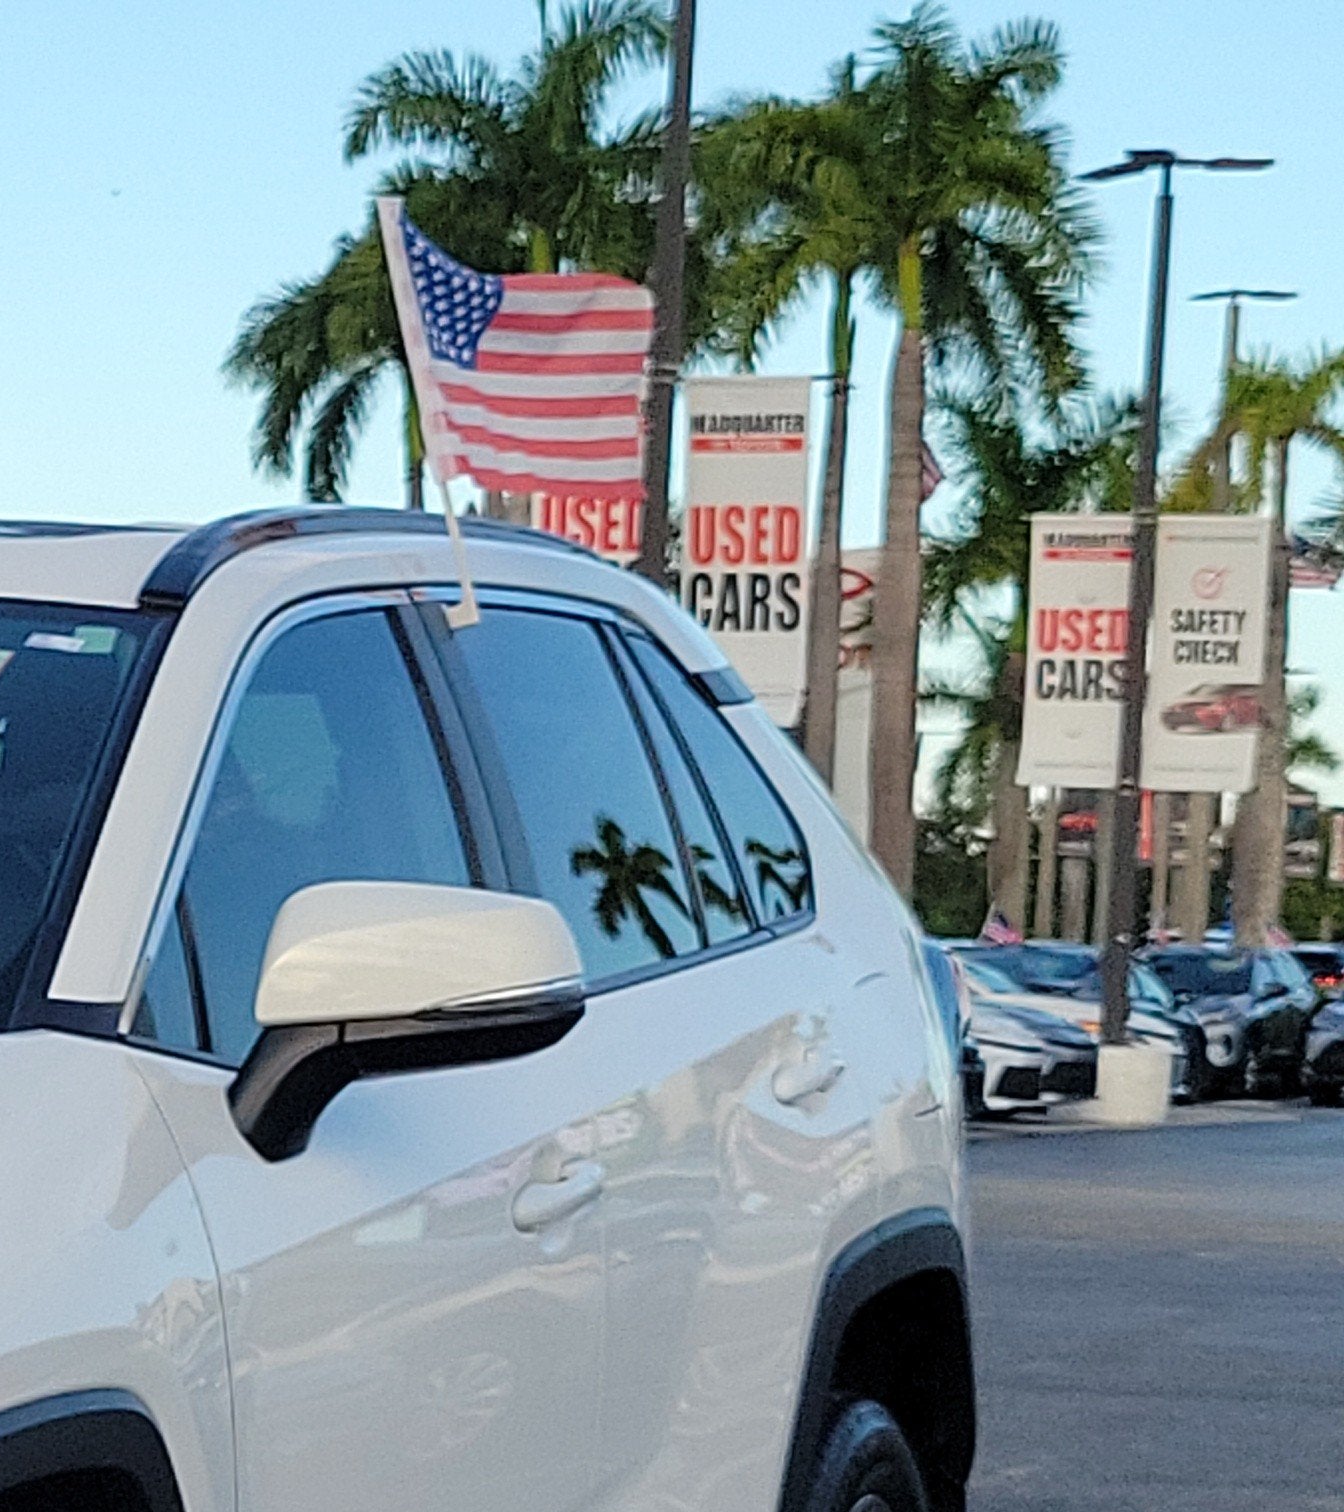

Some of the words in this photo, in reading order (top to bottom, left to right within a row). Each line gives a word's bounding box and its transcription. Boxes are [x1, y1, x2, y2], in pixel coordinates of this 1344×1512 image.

[691, 414, 804, 435] HEADQUARTER
[691, 506, 800, 565] USED
[691, 573, 800, 632] CARS
[1170, 608, 1246, 634] SAFETY
[1038, 609, 1130, 652] USED
[1173, 640, 1240, 665] CHECK
[1037, 659, 1131, 701] CARS
